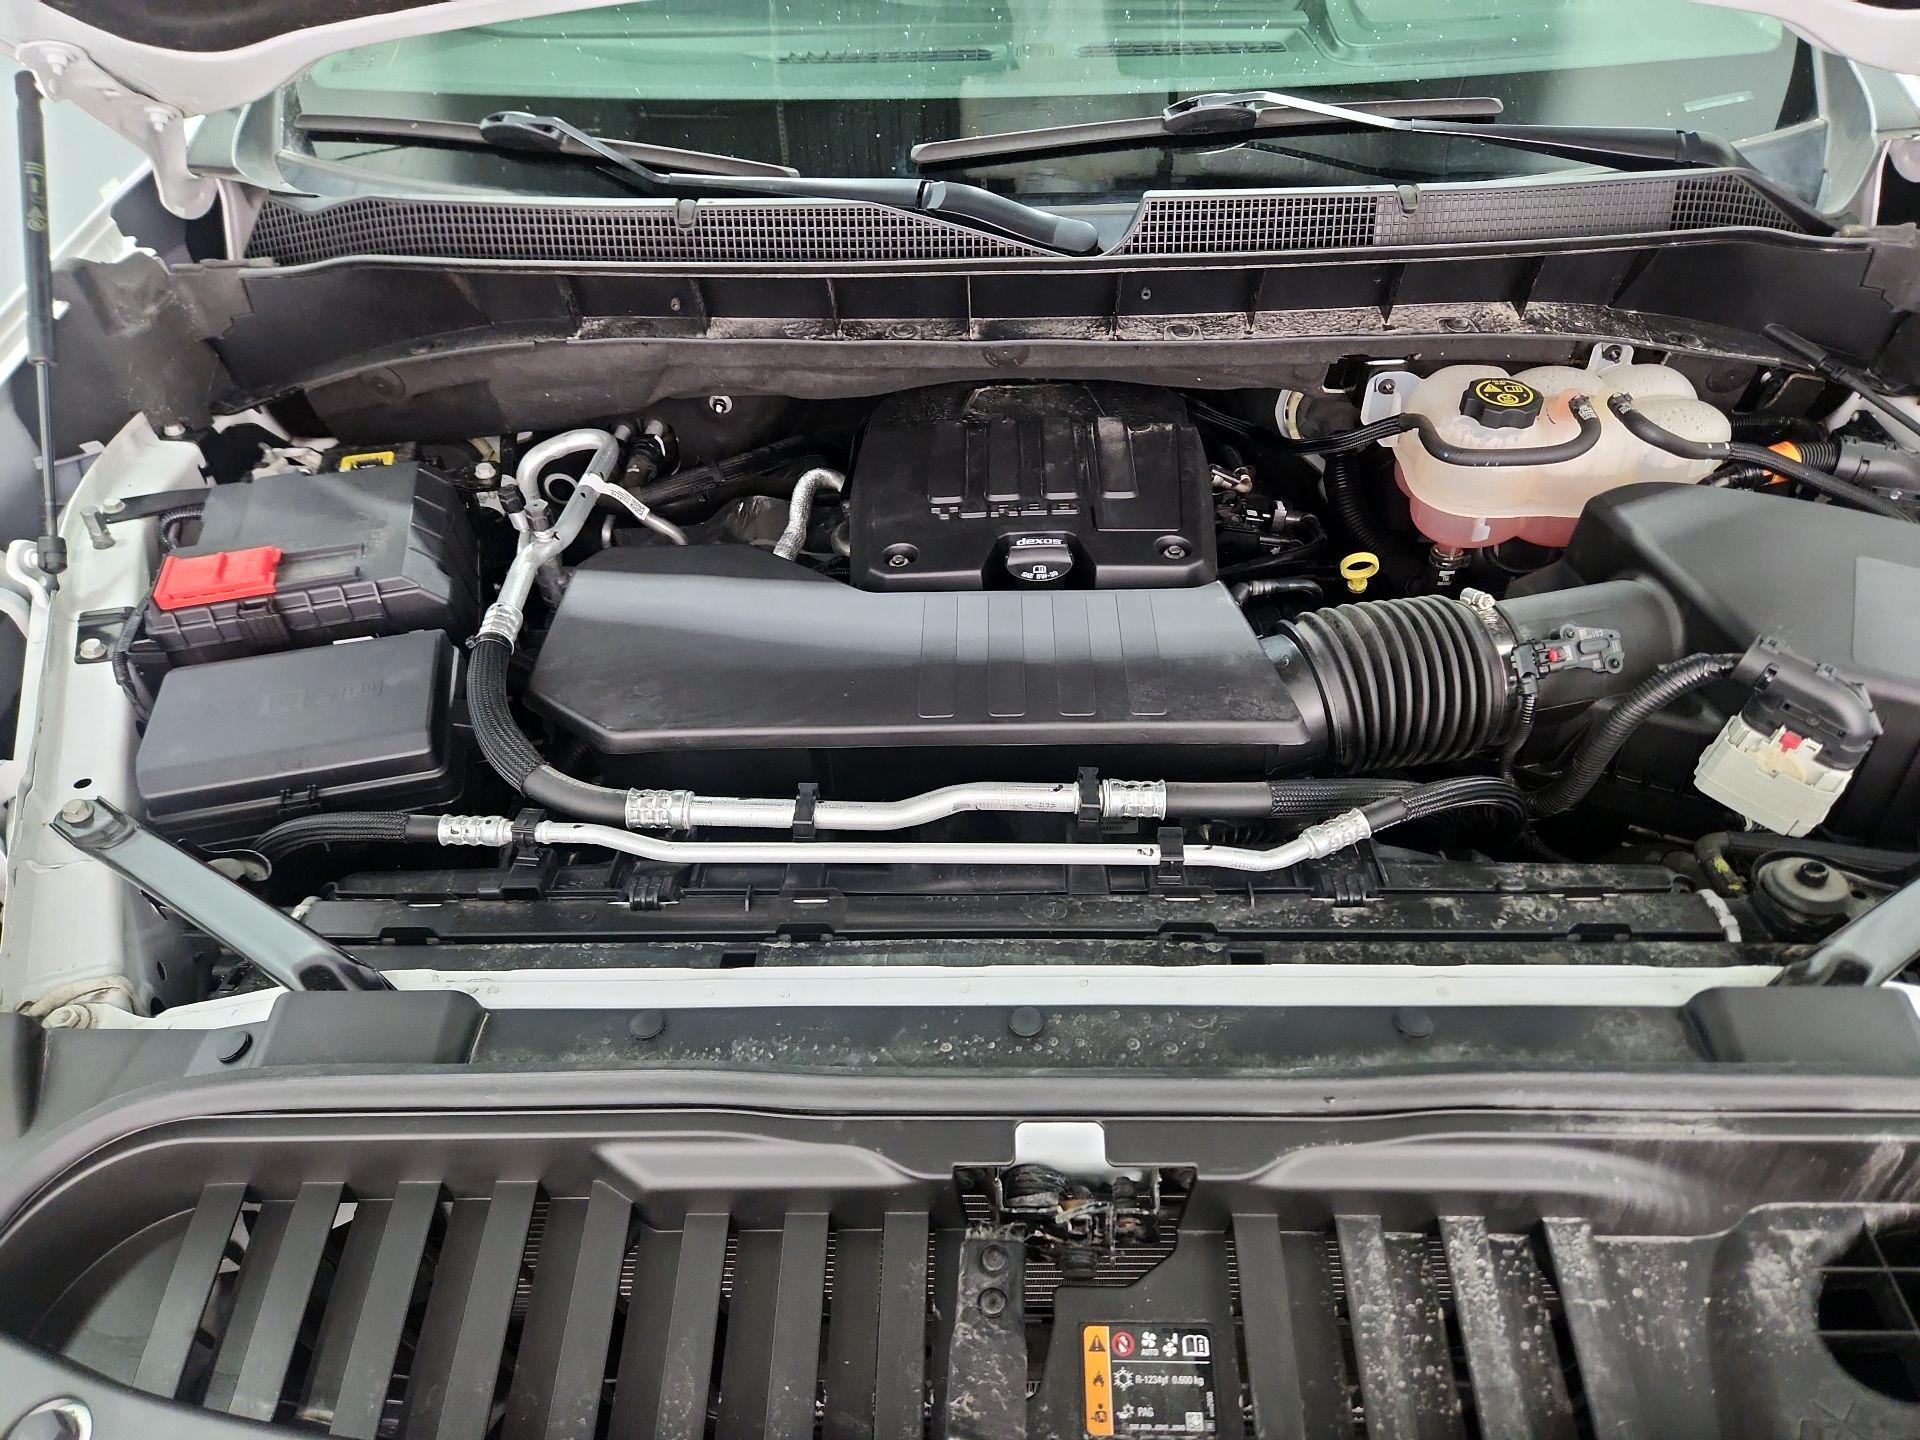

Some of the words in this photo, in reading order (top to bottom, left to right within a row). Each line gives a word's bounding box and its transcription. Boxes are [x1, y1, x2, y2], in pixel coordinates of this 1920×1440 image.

[1016, 537, 1063, 546] dexos
[1140, 1348, 1159, 1356] AUTO
[1137, 1406, 1155, 1418] PAG
